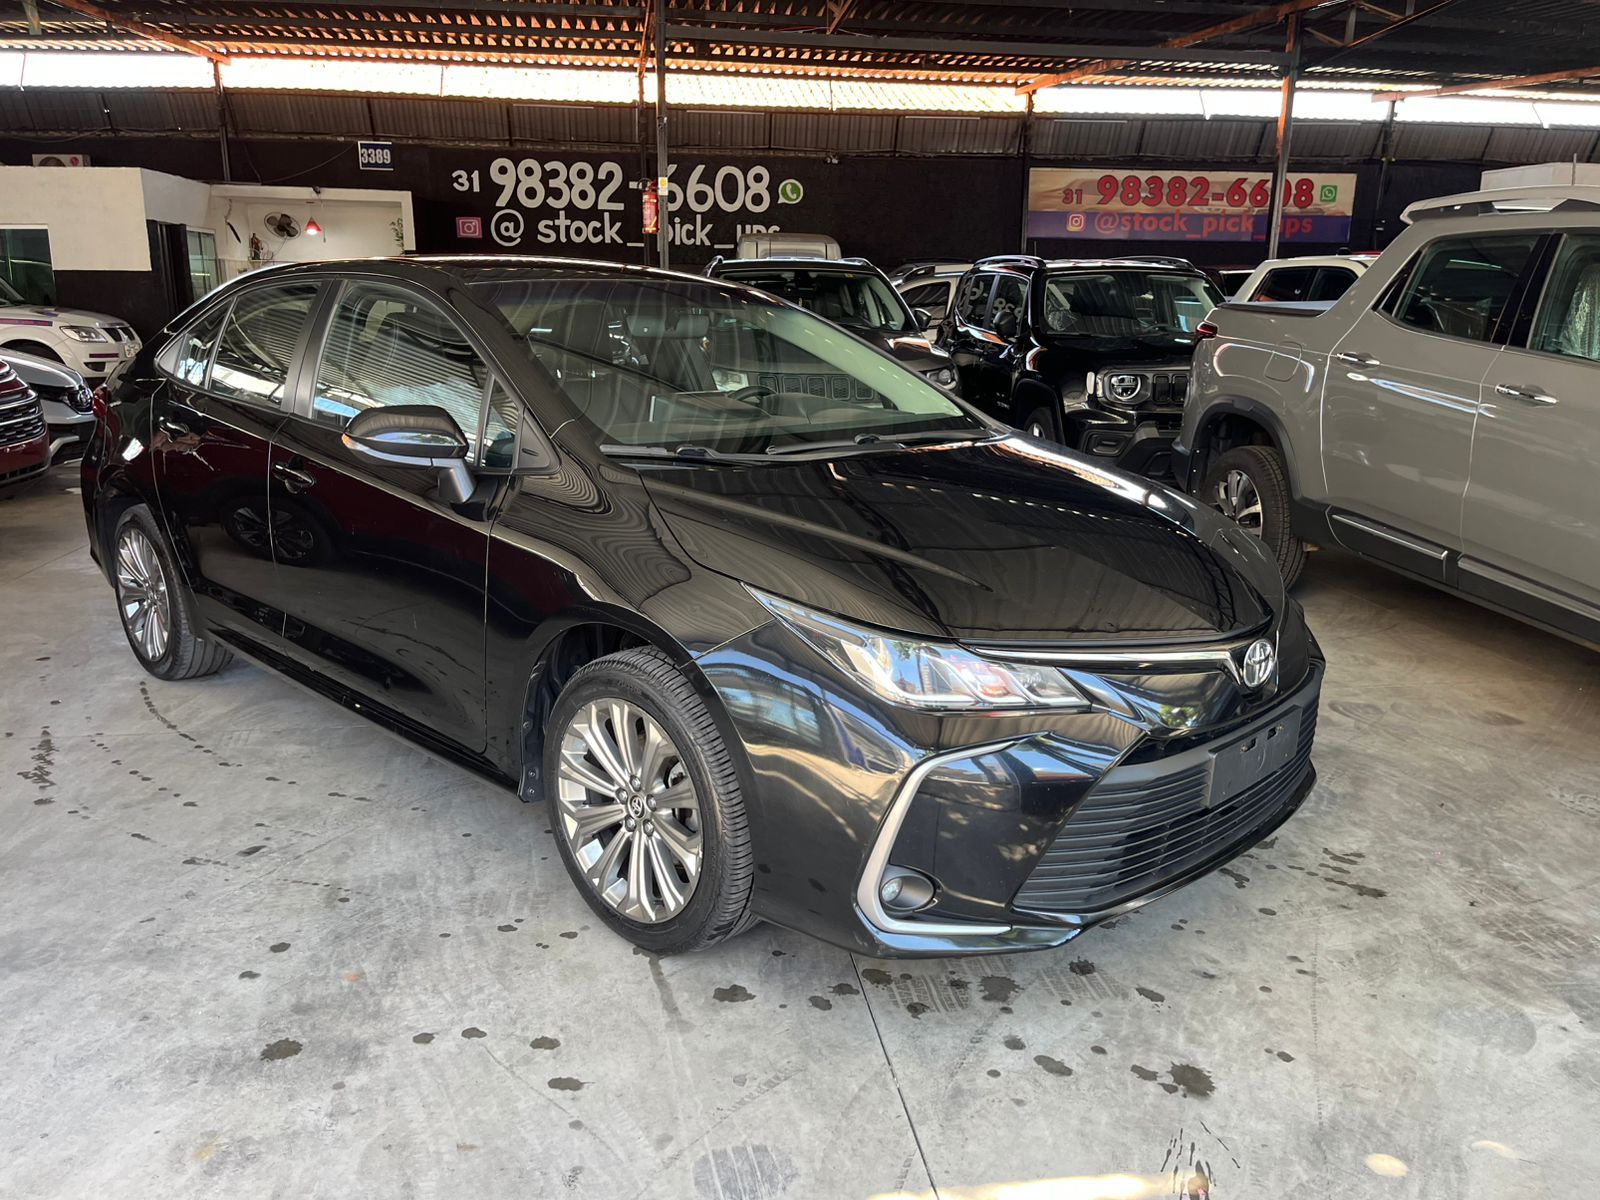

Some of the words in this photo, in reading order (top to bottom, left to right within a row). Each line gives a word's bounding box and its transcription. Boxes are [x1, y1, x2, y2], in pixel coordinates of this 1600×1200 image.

[361, 148, 391, 164] 3389
[452, 170, 480, 192] 31
[1062, 188, 1083, 205] 31
